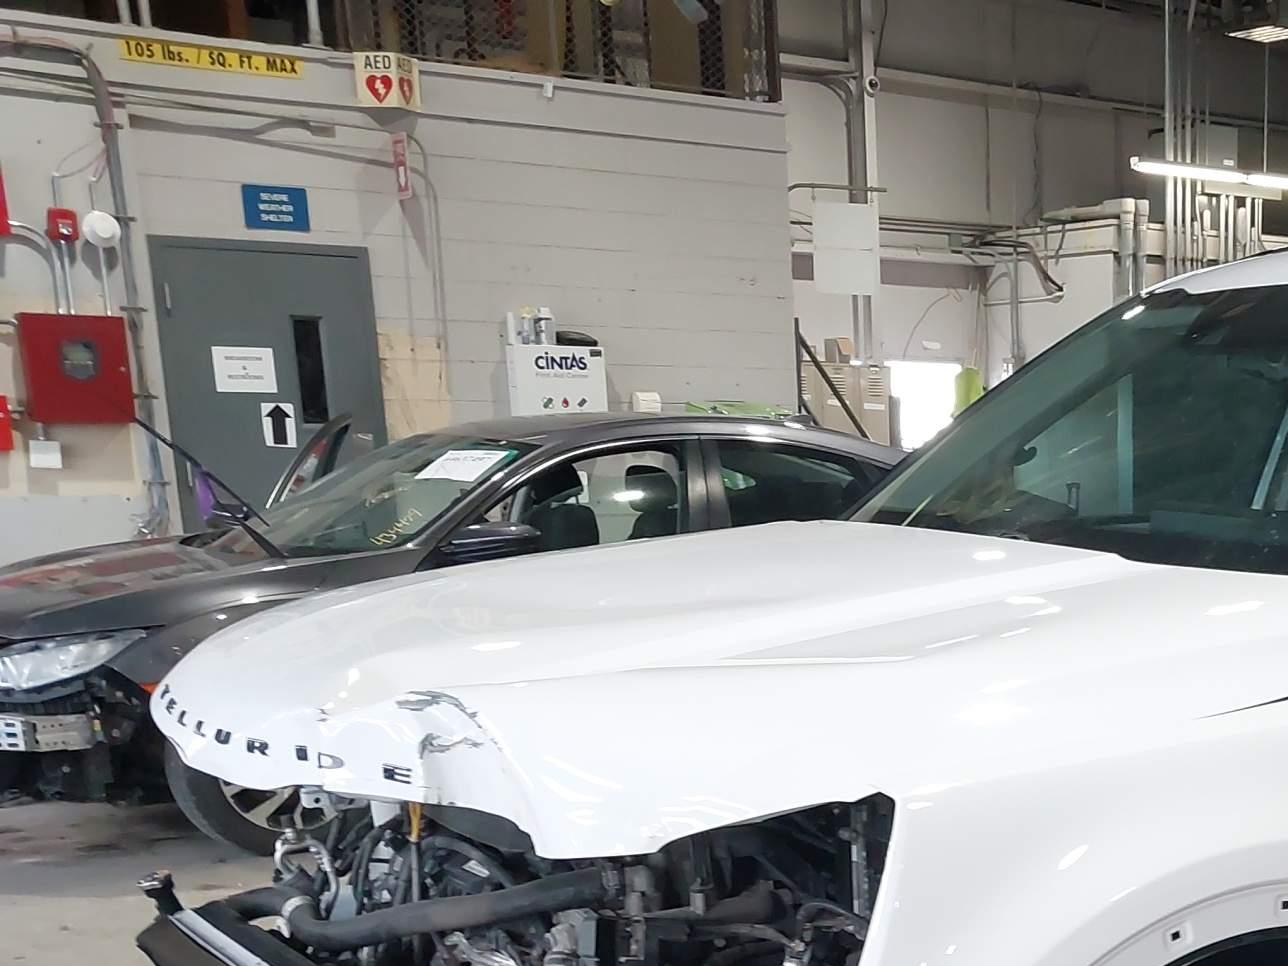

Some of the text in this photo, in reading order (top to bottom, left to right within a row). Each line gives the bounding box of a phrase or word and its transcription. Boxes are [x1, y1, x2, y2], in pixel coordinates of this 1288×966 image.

[124, 40, 155, 59] 105
[161, 44, 190, 63] lbs.
[208, 51, 232, 68] SQ.
[239, 55, 259, 71] FT.
[266, 56, 298, 75] MAX
[364, 55, 392, 70] AED
[534, 351, 588, 371] CINTAS
[160, 683, 412, 785] TELLURIDE
